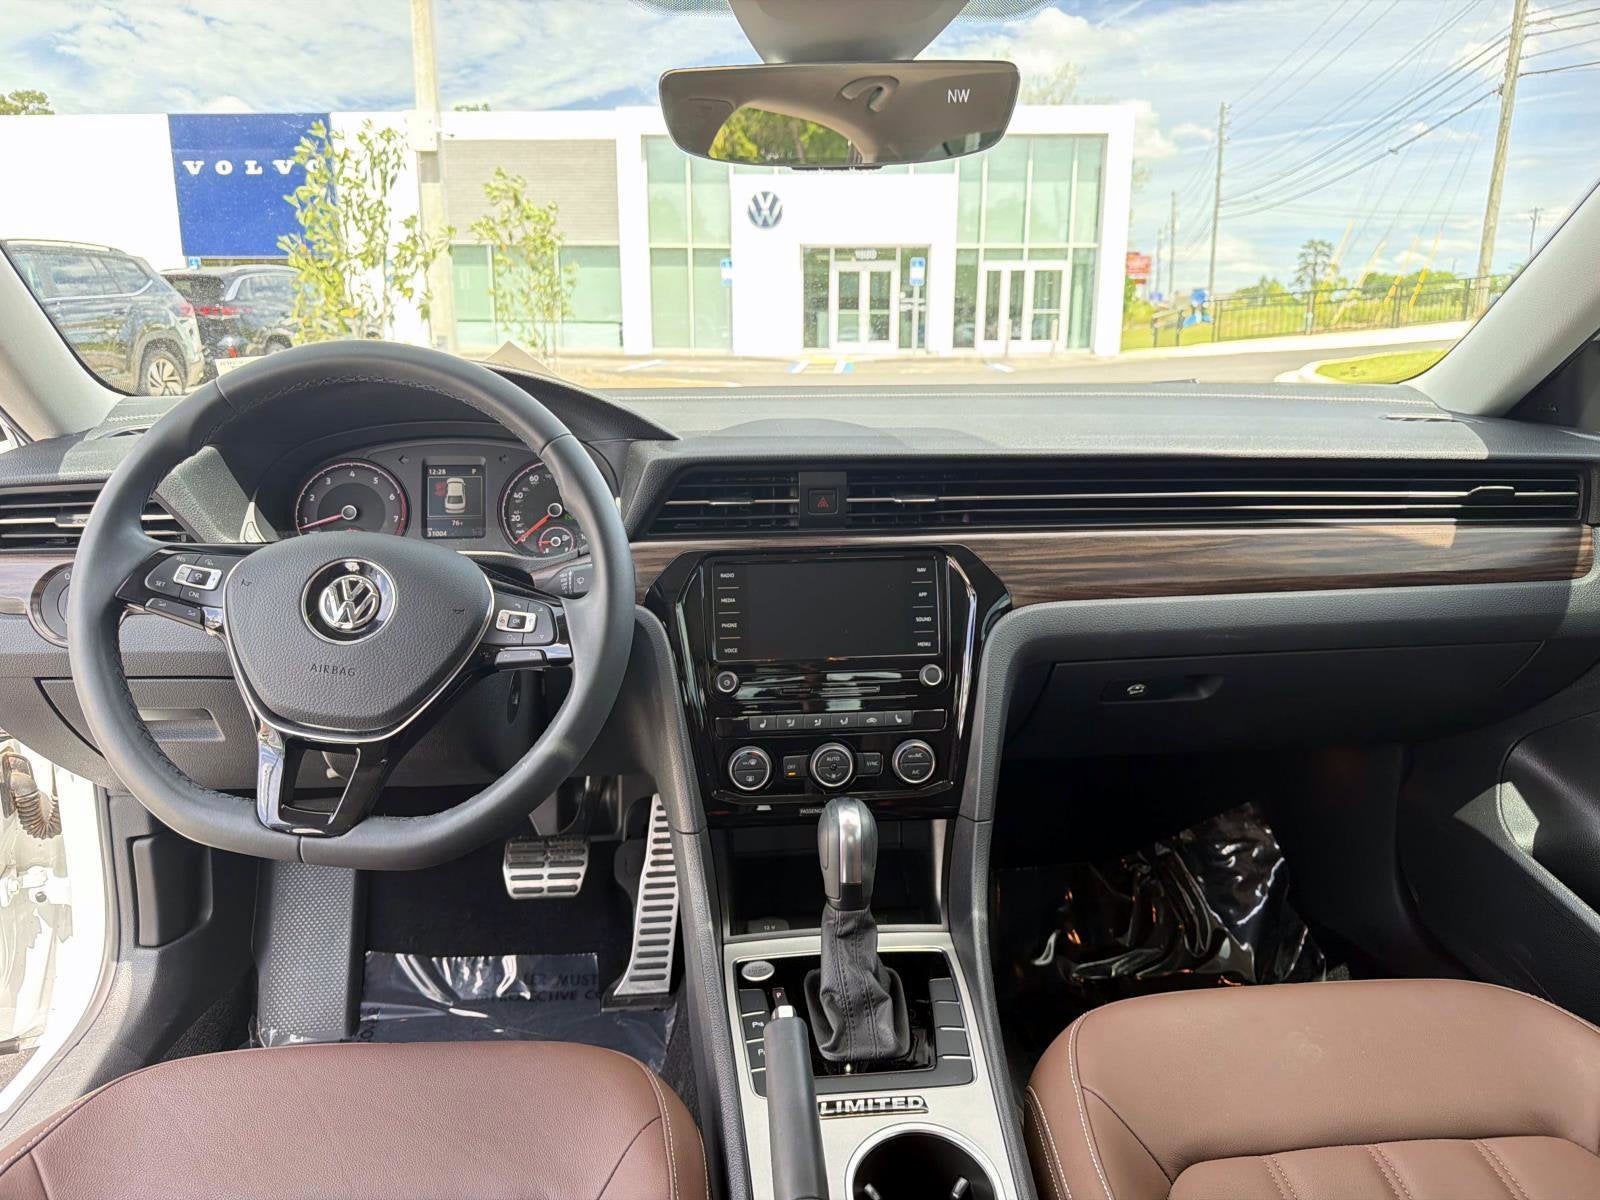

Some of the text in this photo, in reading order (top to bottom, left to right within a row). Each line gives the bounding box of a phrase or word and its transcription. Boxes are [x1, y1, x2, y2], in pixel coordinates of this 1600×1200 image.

[947, 88, 971, 103] NW
[349, 470, 356, 478] 4
[529, 474, 540, 482] 60
[325, 477, 332, 485] 3
[372, 477, 379, 485] 5
[309, 494, 316, 502] 2
[389, 493, 396, 501] 6
[513, 491, 524, 499] 40
[393, 515, 399, 523] 7
[511, 514, 521, 522] 20
[310, 663, 356, 677] AIRBAG
[820, 1096, 925, 1115] LIMITED
